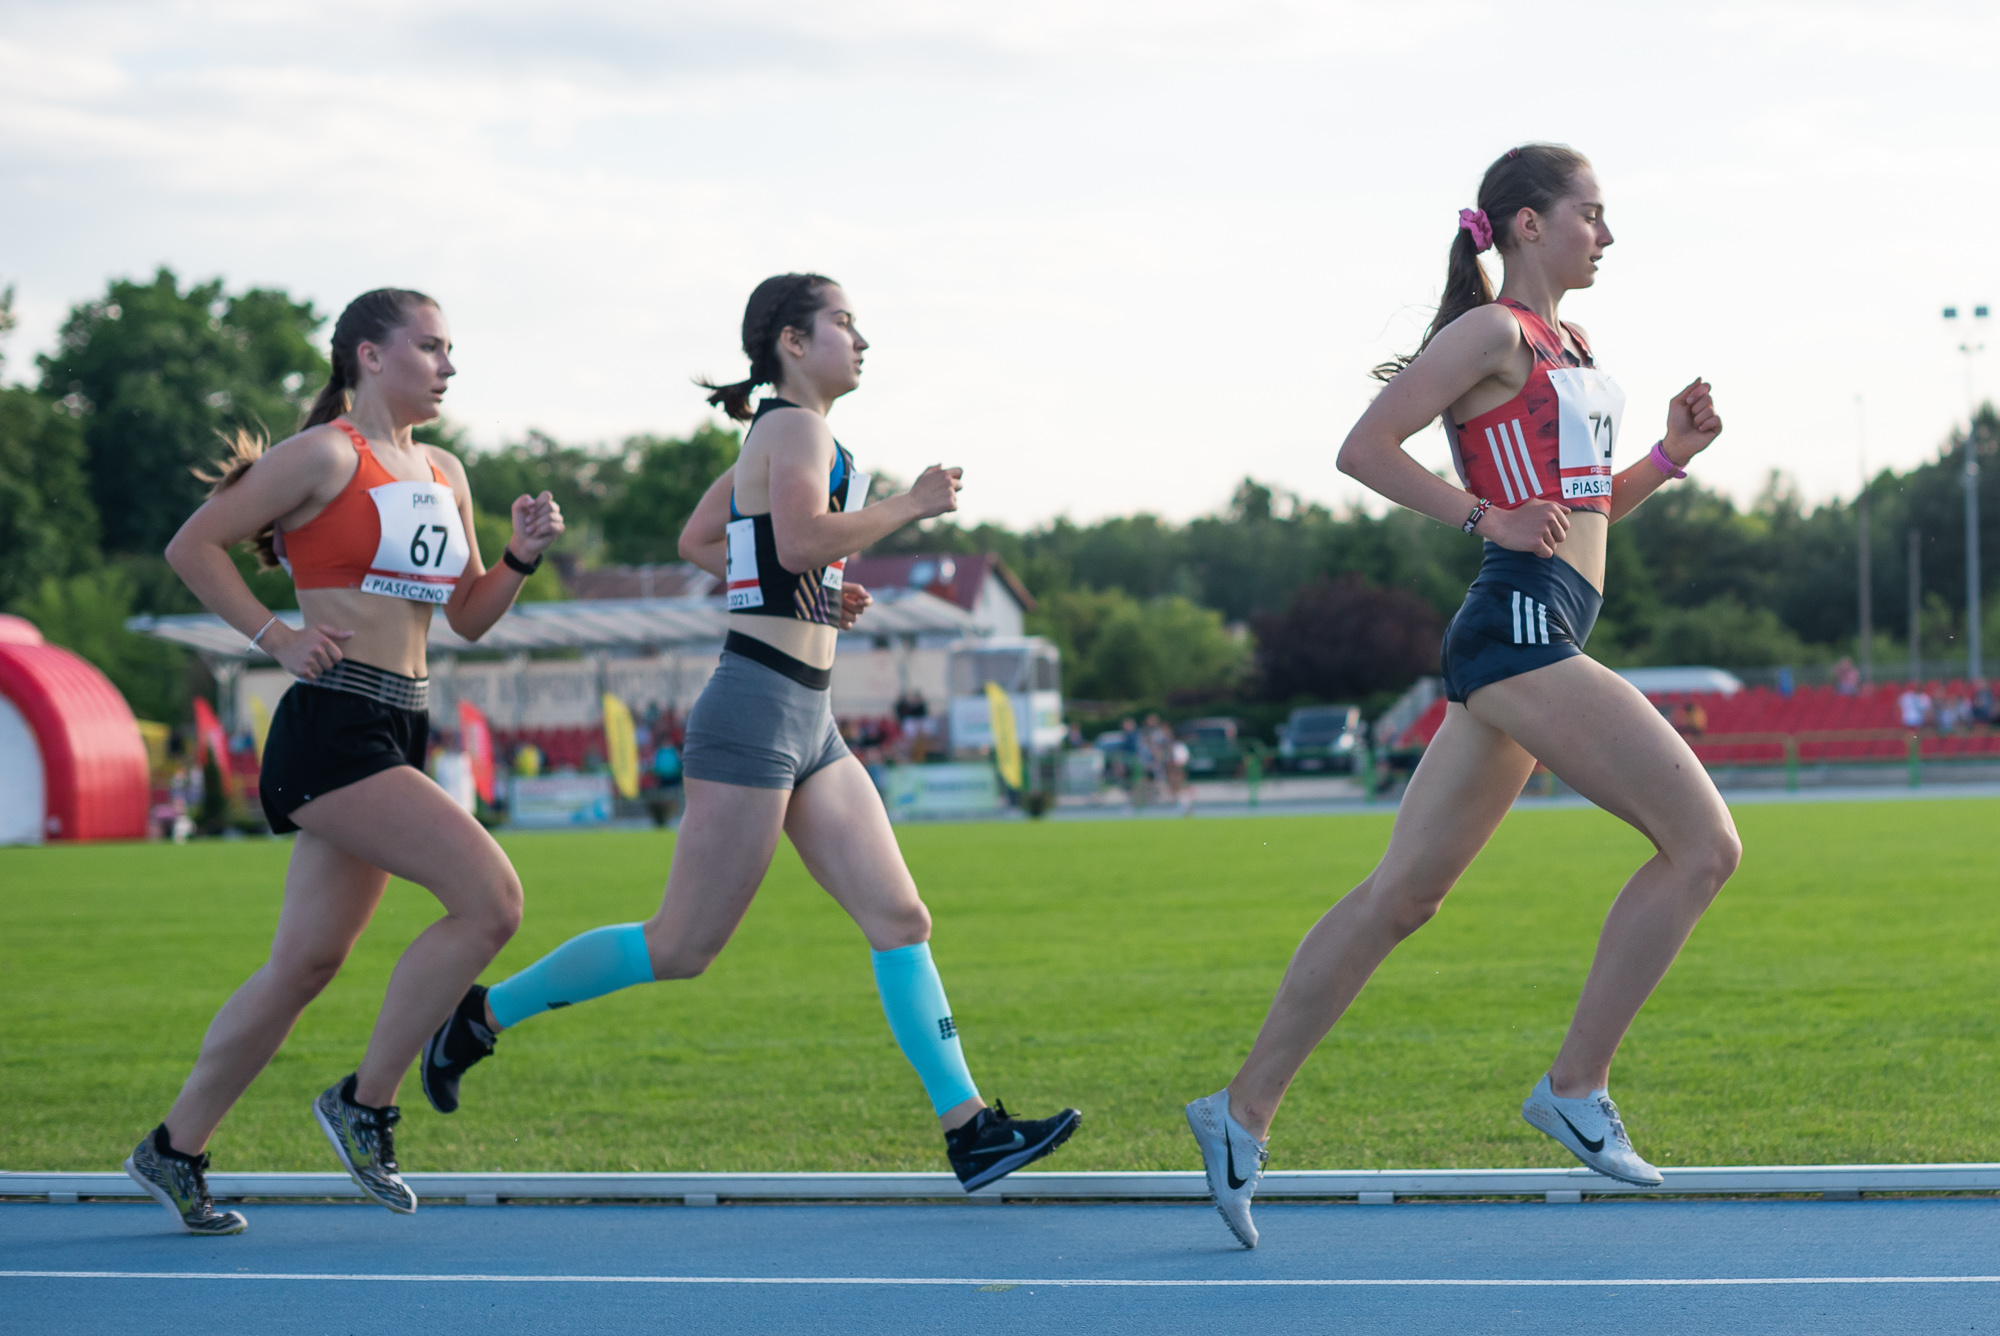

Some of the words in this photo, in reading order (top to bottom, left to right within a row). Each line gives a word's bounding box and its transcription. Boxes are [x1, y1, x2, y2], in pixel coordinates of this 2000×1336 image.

[1588, 411, 1612, 458] 71
[410, 524, 448, 567] 67
[372, 579, 443, 601] PIASECZNO
